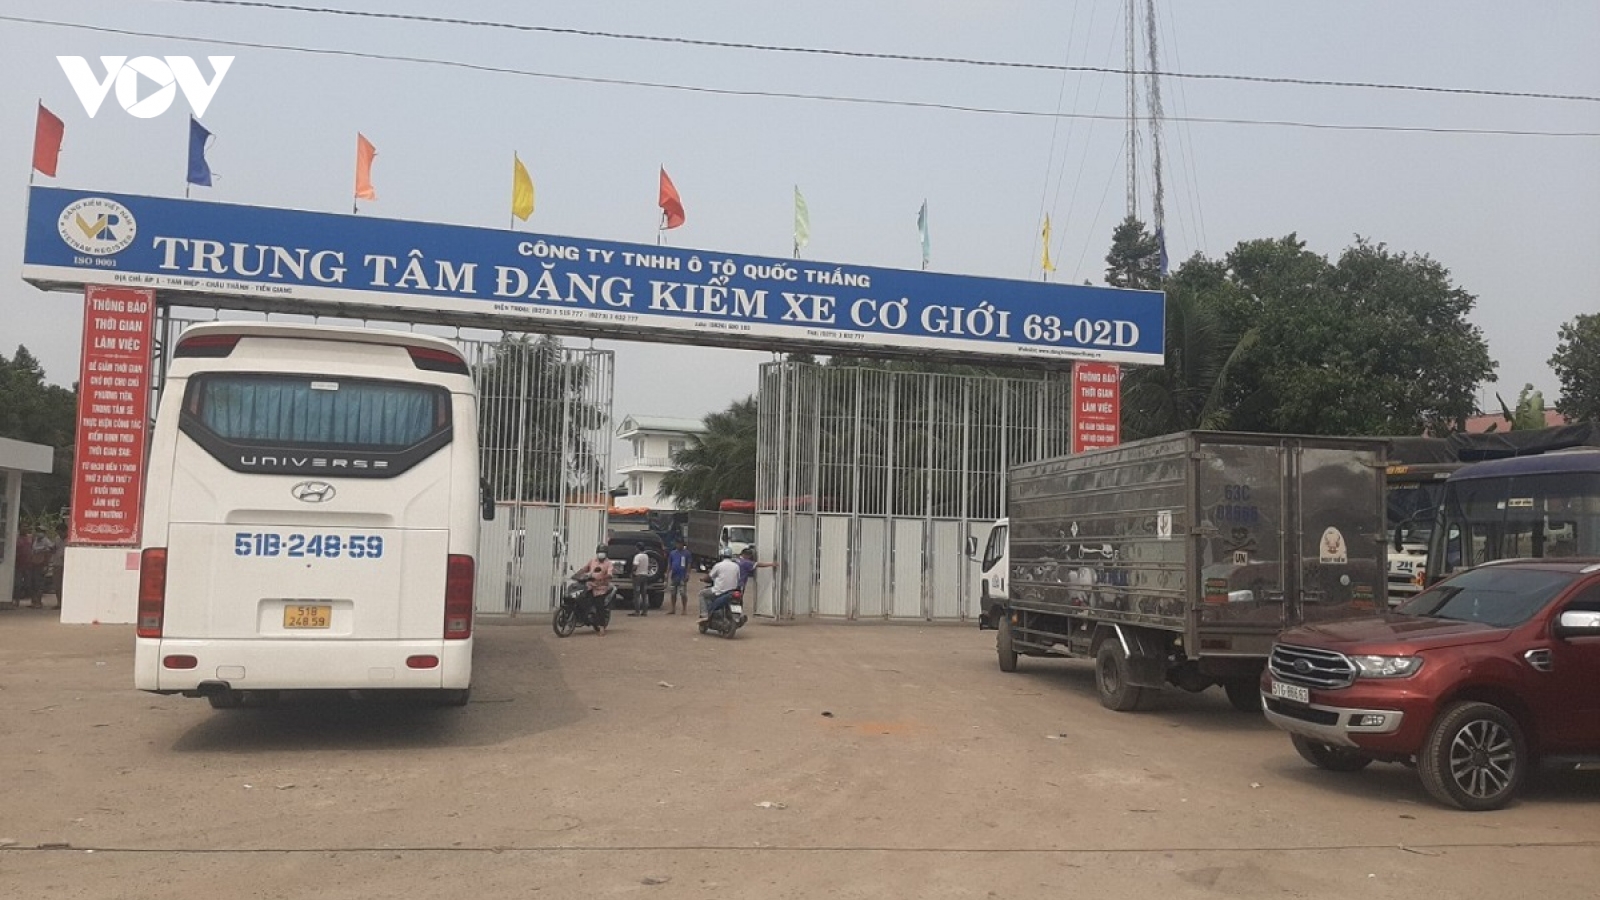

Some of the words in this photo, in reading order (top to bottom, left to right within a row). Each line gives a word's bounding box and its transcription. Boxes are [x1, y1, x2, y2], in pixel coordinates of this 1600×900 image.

[95, 258, 117, 266] 9001
[518, 240, 580, 260] CÔNG
[587, 248, 615, 263] TY
[622, 252, 680, 270] TNHH
[687, 255, 702, 272] Ô
[709, 259, 737, 276] TÔ
[743, 262, 798, 281] QUỐC
[804, 267, 870, 288] THẮNG
[153, 236, 347, 283] TRUNG
[364, 249, 478, 294] TÂM
[493, 261, 634, 308] ĐĂNG
[648, 276, 769, 319] KIỂM
[781, 291, 836, 324] XE
[851, 297, 909, 330] CƠ
[921, 301, 1011, 338] GIỚI
[1023, 314, 1140, 347] 63-02D
[92, 298, 124, 312] THÔNG
[127, 300, 147, 313] BÁO
[95, 317, 116, 330] THỜI
[119, 320, 143, 332] GIAN
[94, 335, 116, 349] LÀM
[118, 338, 140, 353] VIỆC
[240, 456, 389, 468] UNIVERSE
[1225, 484, 1250, 499] 63C
[1236, 553, 1246, 563] UN
[298, 607, 317, 616] 51B
